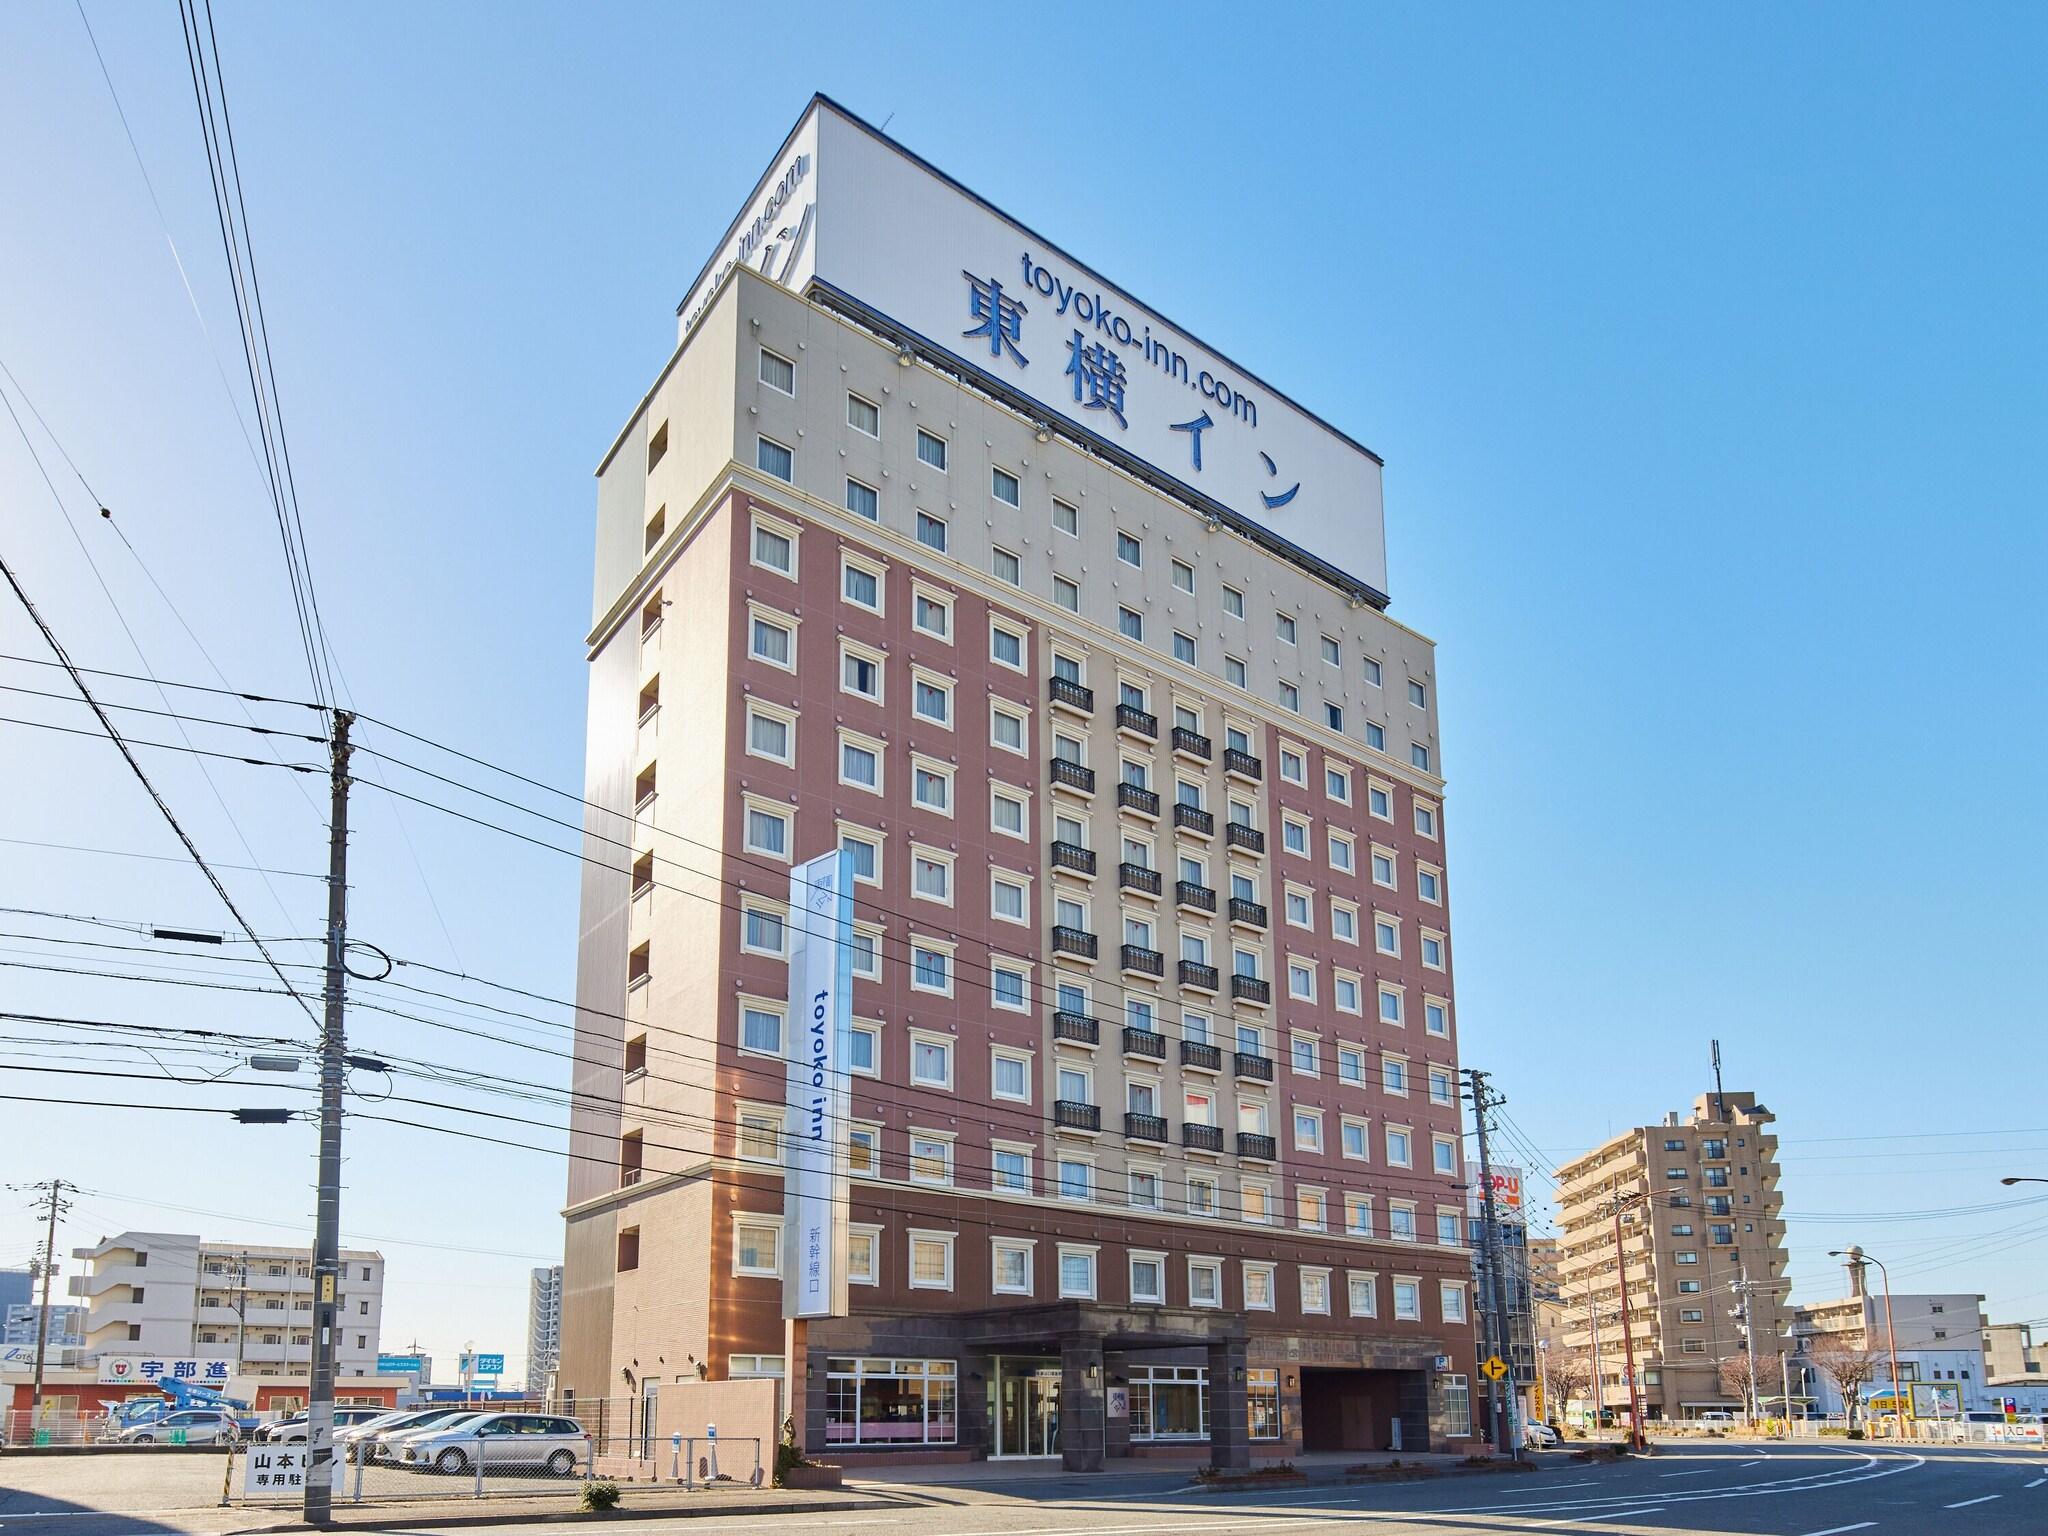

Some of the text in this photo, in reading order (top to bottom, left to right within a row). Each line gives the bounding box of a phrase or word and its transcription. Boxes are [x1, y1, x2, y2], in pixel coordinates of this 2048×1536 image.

[1022, 251, 1257, 428] toyoko-inn.com
[961, 269, 1300, 509] 東横イン
[811, 990, 829, 1141] toyoko inn
[809, 1226, 821, 1293] 新幹線口
[1439, 1357, 1445, 1366] P
[2006, 1398, 2014, 1406] P
[2007, 1426, 2024, 1435] 入口
[254, 1453, 338, 1469] 山本
